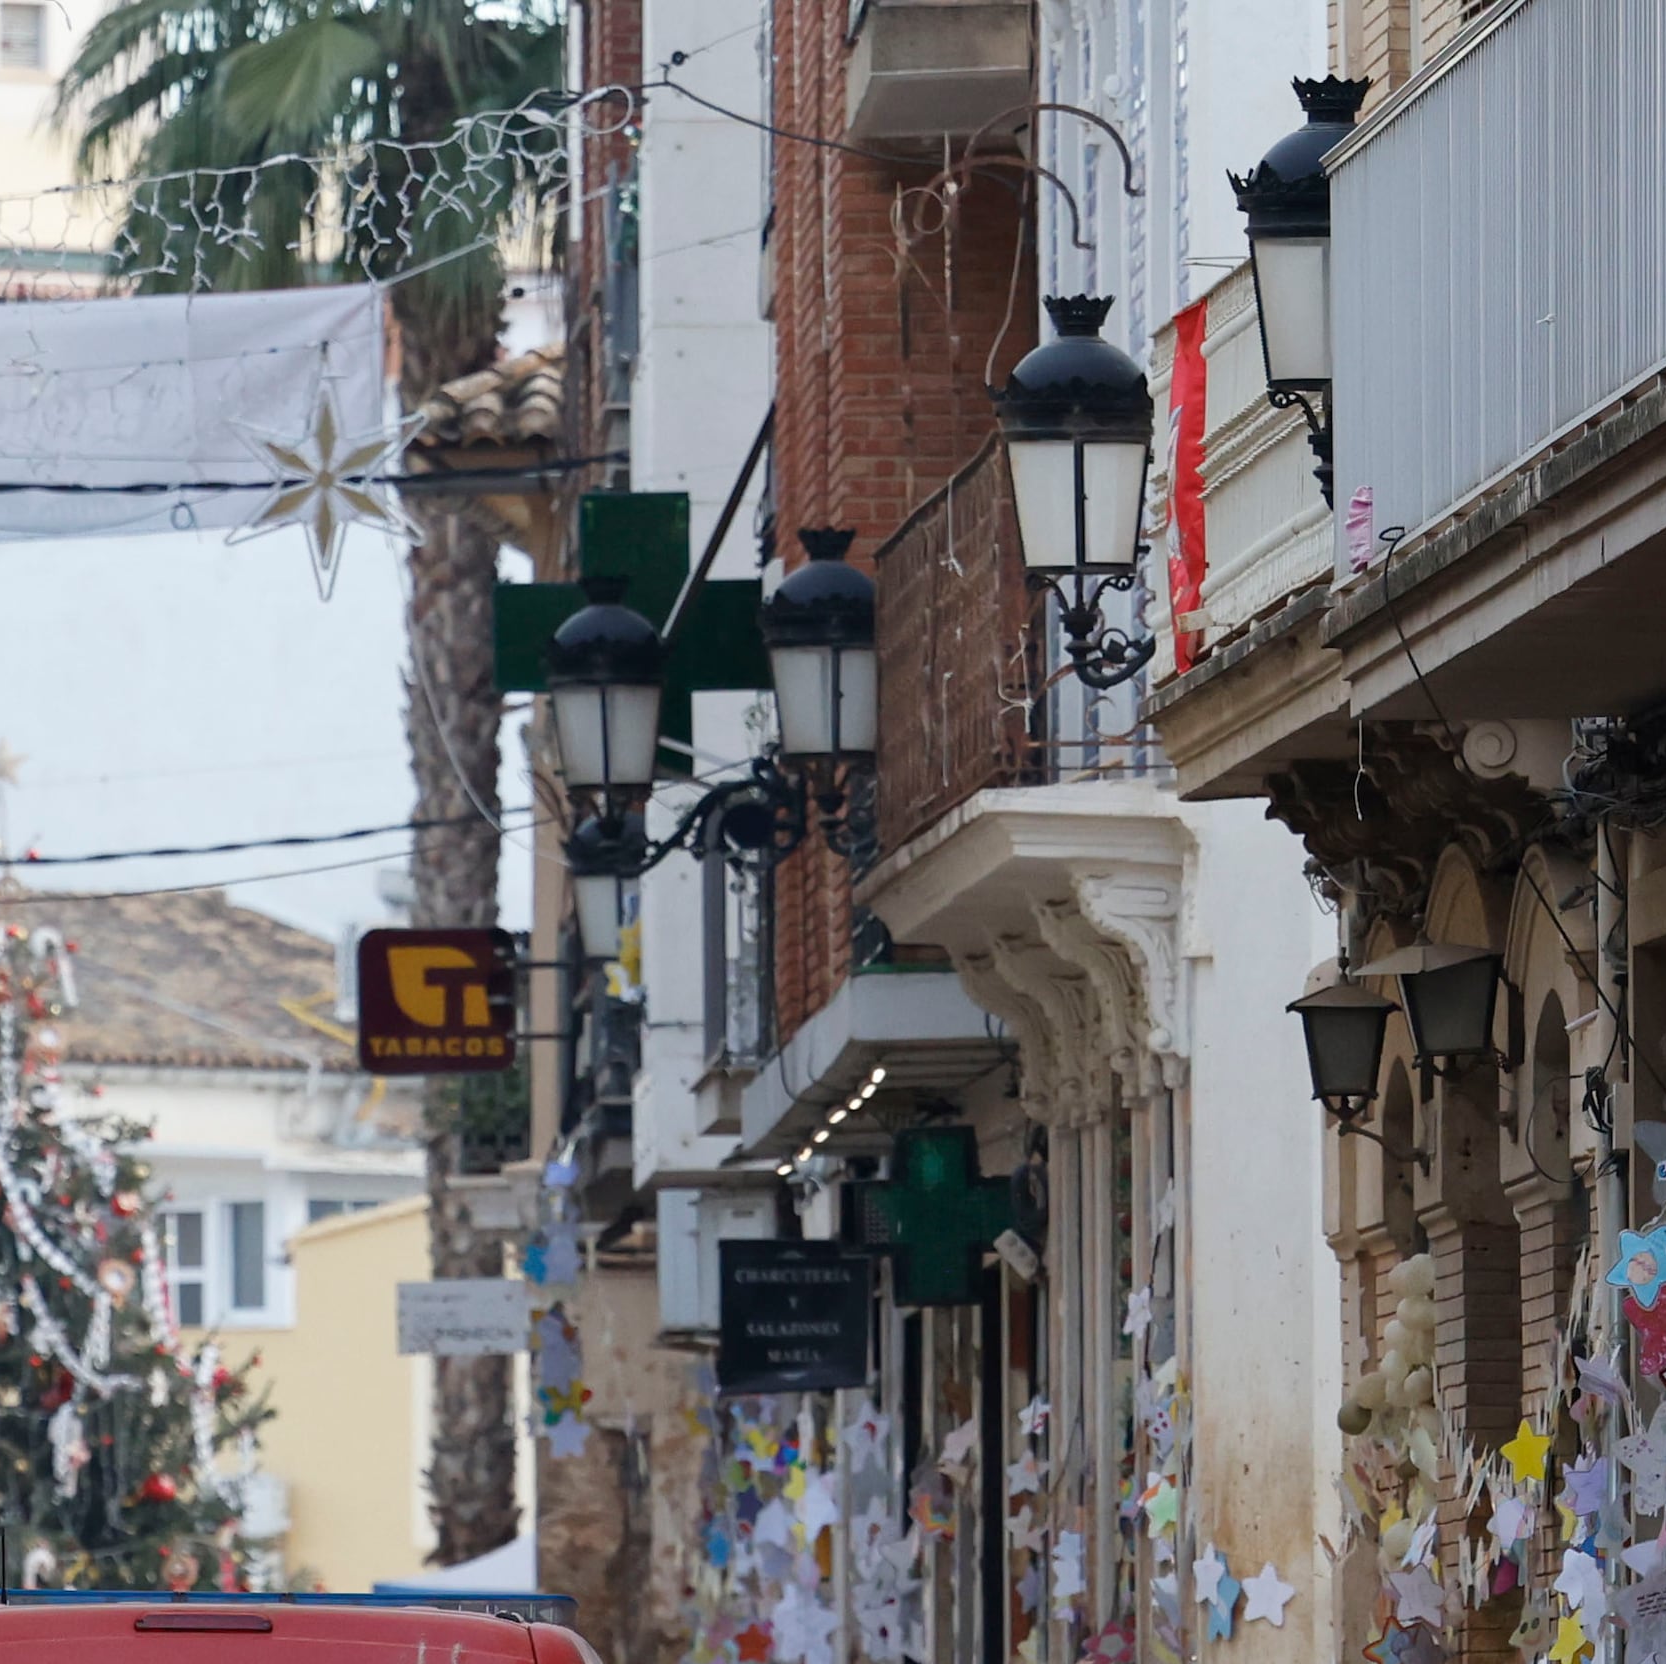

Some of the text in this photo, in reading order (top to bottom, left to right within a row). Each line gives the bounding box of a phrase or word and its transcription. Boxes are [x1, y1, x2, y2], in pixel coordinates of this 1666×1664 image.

[369, 1036, 505, 1058] TABACOS
[735, 1268, 851, 1284] CHARCUTERÍA
[789, 1296, 798, 1309] Y
[746, 1321, 842, 1337] SALAZONES
[767, 1347, 822, 1363] MARÍA
